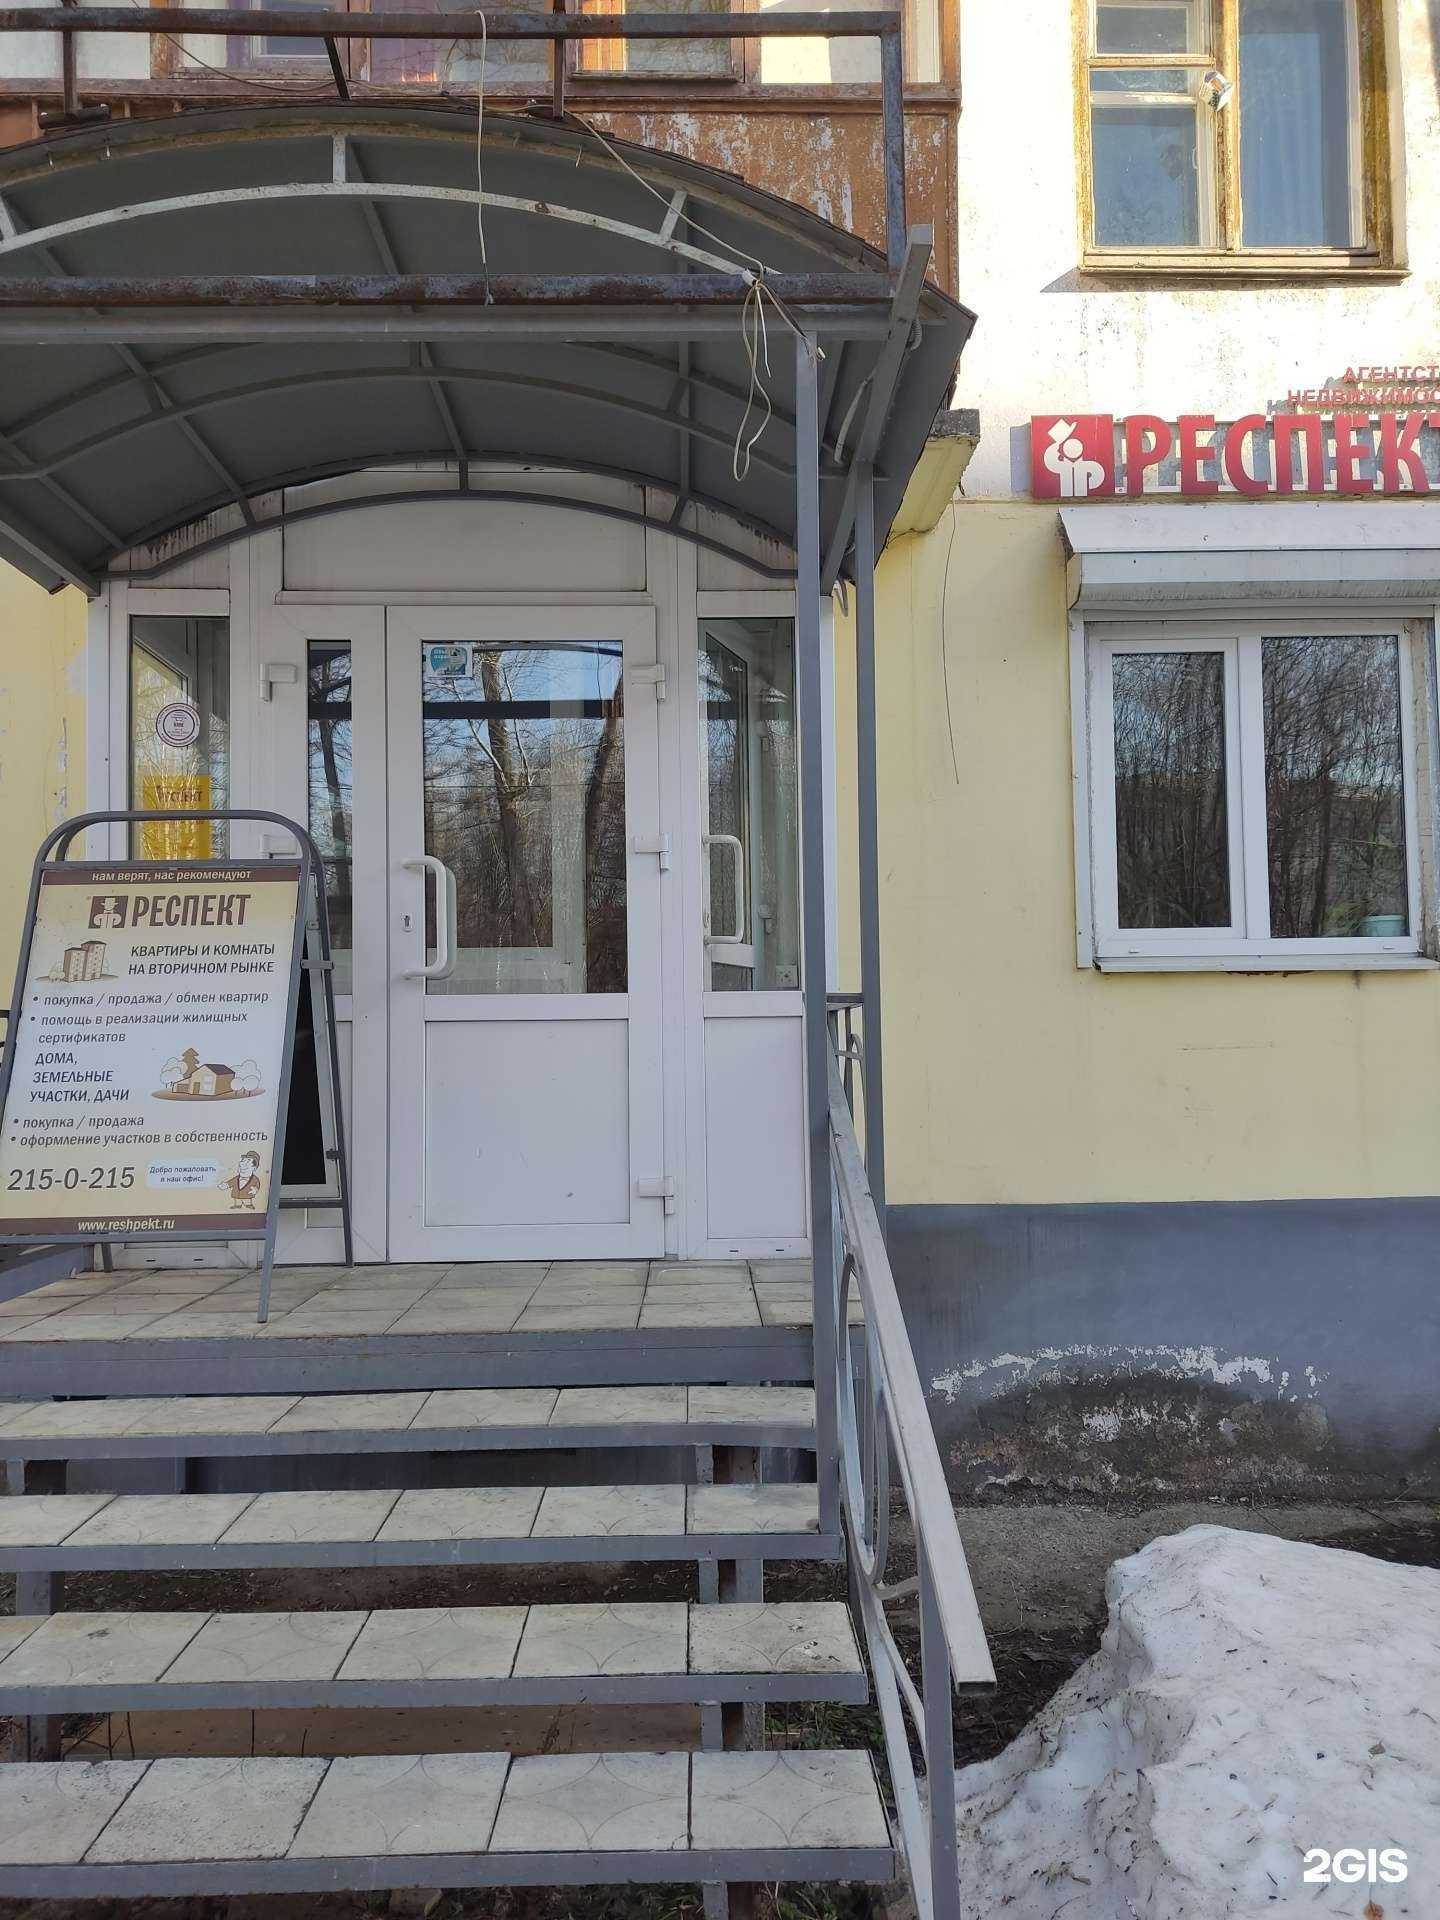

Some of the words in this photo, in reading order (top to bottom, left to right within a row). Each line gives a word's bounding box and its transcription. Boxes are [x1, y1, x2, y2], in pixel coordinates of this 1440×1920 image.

[92, 872, 114, 881] нам
[117, 872, 151, 882] верят,
[154, 871, 174, 880] нас
[176, 869, 251, 881] рекомендуют
[131, 894, 251, 927] РЕСПЕКТ
[131, 945, 198, 957] КВАРТИРЫ
[201, 945, 210, 956] И
[213, 943, 275, 956] КОМНАТЫ
[128, 963, 145, 975] НА
[149, 962, 228, 975] ВТОРИЧНОМ
[231, 961, 275, 973] РЫНКЕ
[44, 996, 93, 1006] покупка
[108, 995, 162, 1006] продажа
[176, 992, 217, 1003] обмен
[219, 992, 268, 1005] квартир
[41, 1015, 92, 1027] помощь
[95, 1016, 103, 1025] в
[105, 1013, 180, 1027] реализации
[182, 1012, 247, 1024] жилищных
[38, 1031, 126, 1045] сертификатов
[35, 1052, 78, 1066] ДОМА,
[33, 1071, 114, 1082] ЗЕМЕЛЬНЫЕ
[29, 1090, 91, 1102] УЧАСТКИ,
[93, 1090, 129, 1102] ДАЧИ
[23, 1117, 74, 1129] покупка
[88, 1116, 144, 1128] продажа
[20, 1135, 100, 1148] оформление
[103, 1133, 160, 1147] участков
[164, 1134, 171, 1143] в
[175, 1132, 268, 1143] собственность
[7, 1167, 135, 1191] 215-0-215
[78, 1218, 175, 1231] www.reshpekt.ru
